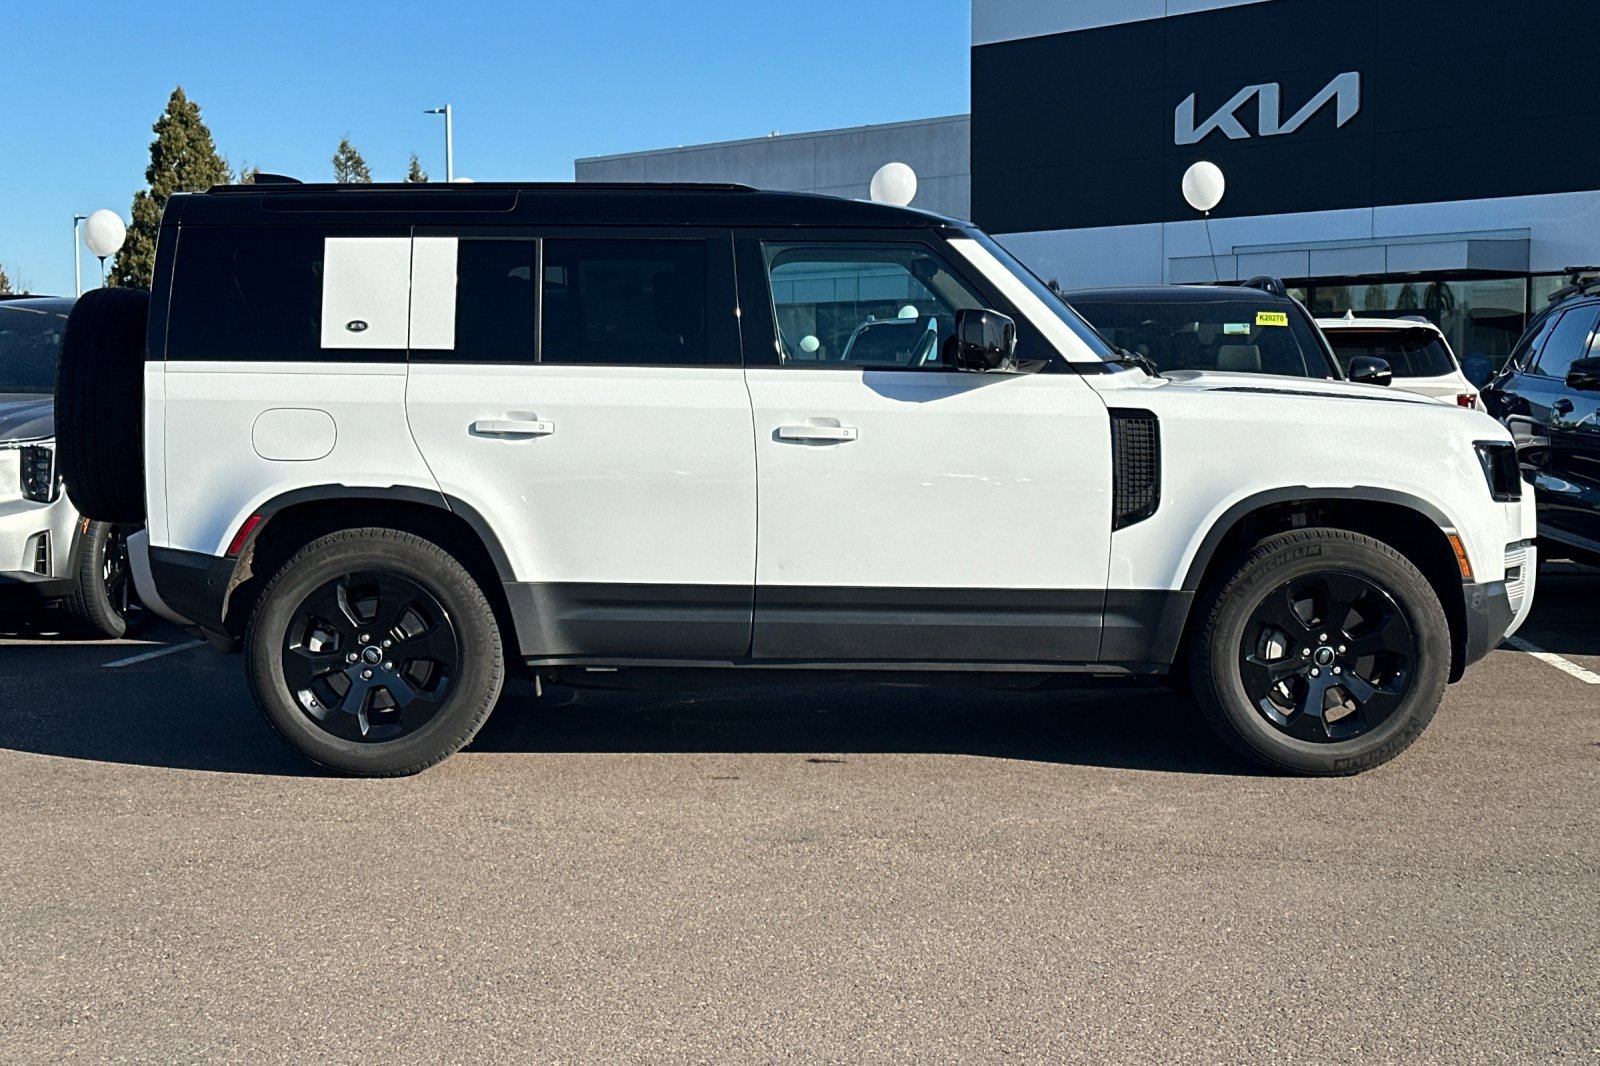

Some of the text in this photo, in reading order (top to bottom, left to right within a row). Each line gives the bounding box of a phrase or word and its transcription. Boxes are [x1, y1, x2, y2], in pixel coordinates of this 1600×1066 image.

[1174, 71, 1360, 145] KIA
[1259, 314, 1284, 322] K20270
[1250, 544, 1321, 580] MICHELIN
